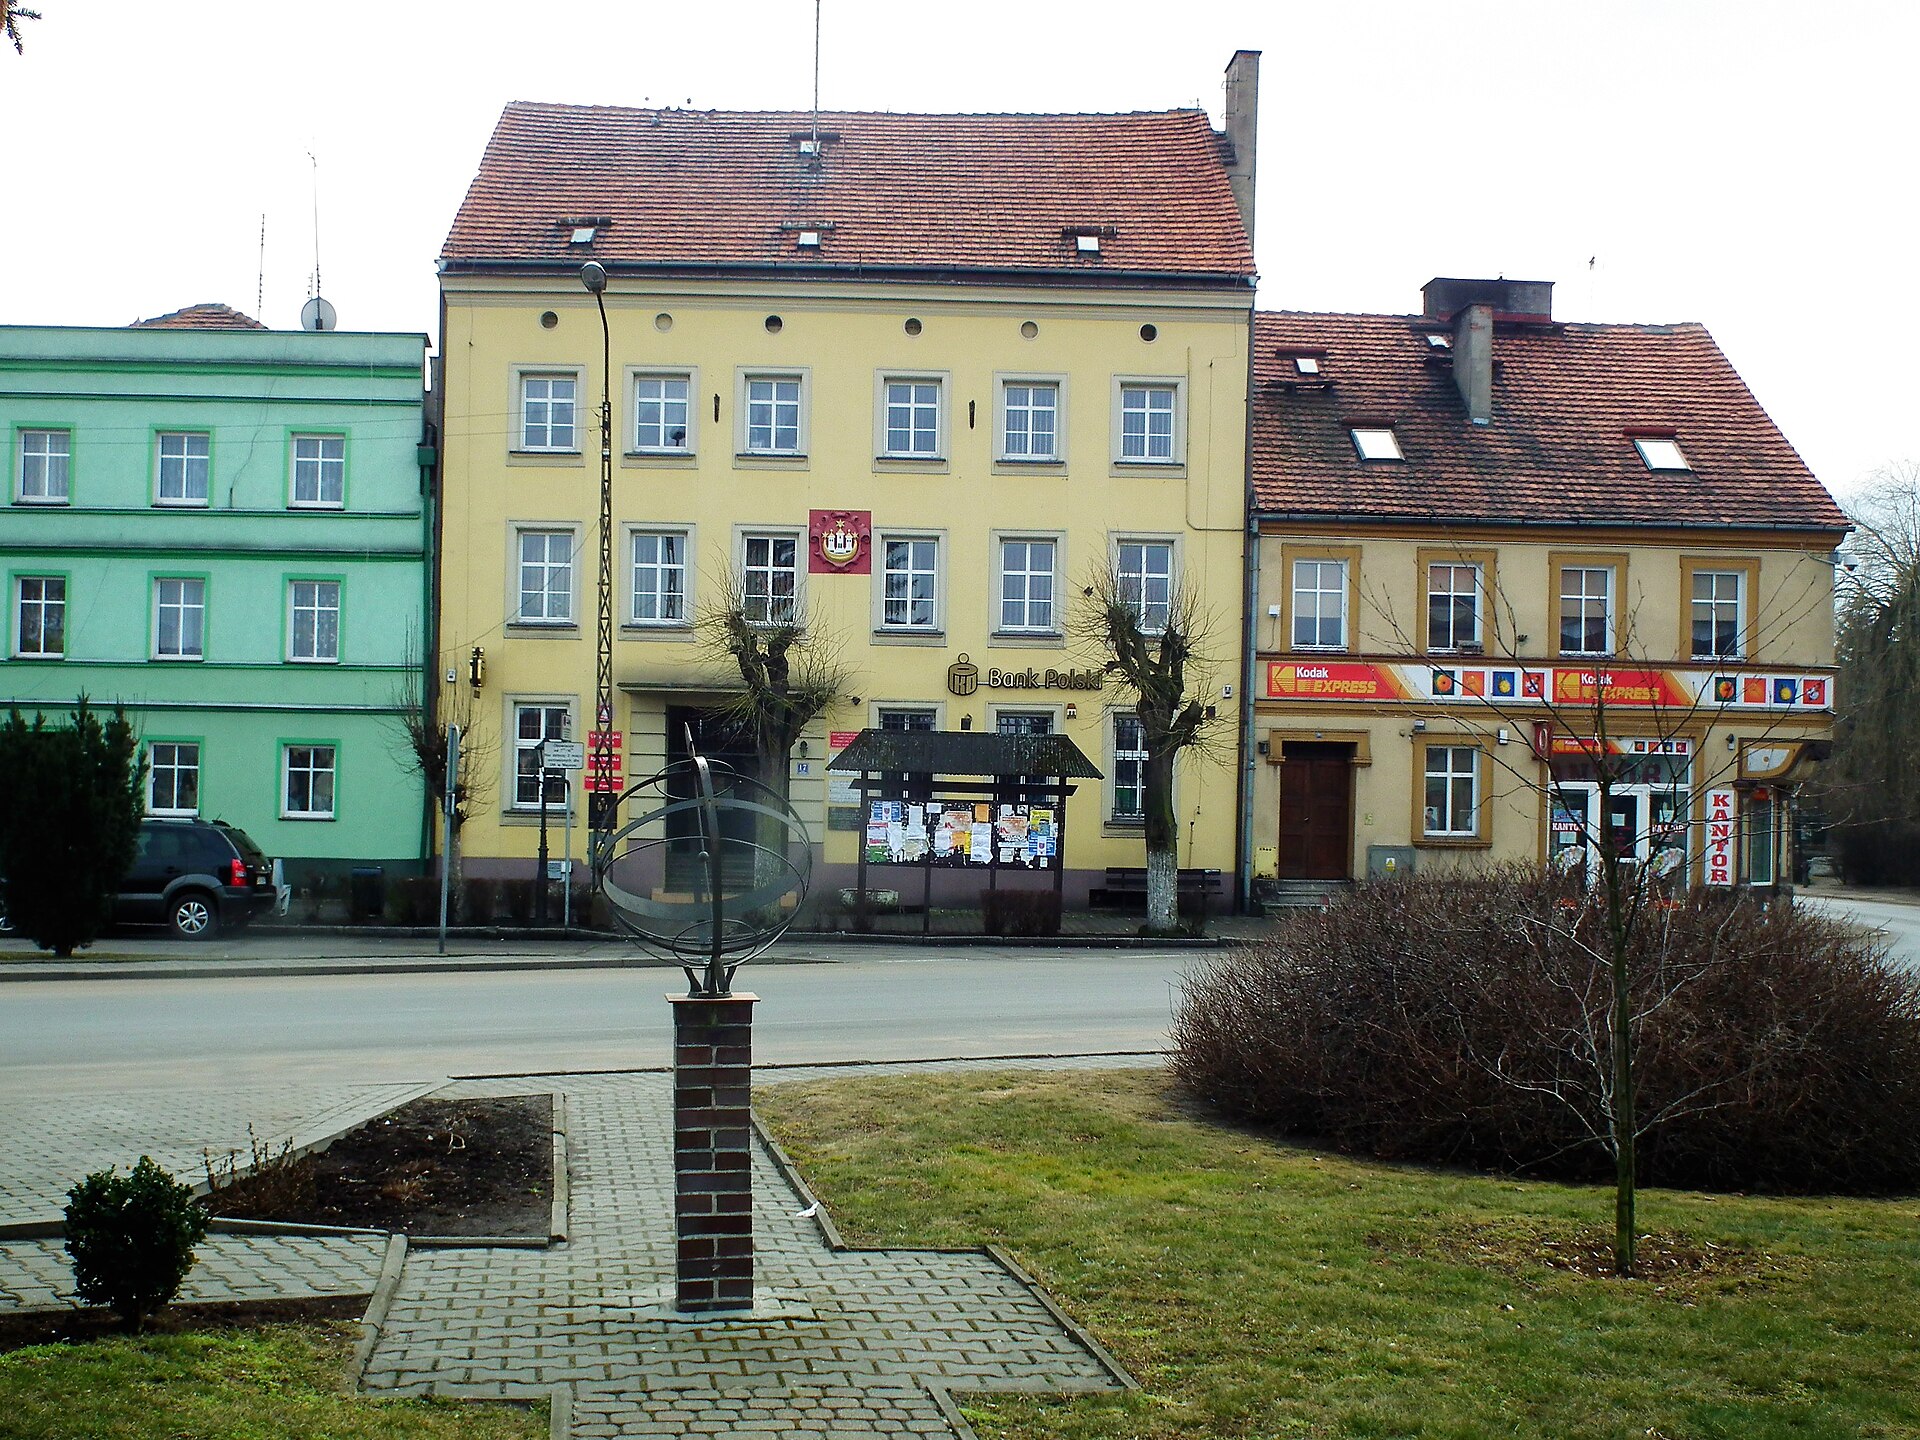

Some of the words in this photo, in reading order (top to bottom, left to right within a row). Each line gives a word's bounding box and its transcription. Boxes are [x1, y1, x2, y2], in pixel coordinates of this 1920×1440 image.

[988, 668, 1039, 689] Bank
[1045, 669, 1103, 690] Polski
[1296, 667, 1328, 678] Kodak
[1313, 681, 1377, 694] EXPRESS
[1711, 794, 1730, 882] KANTOR
